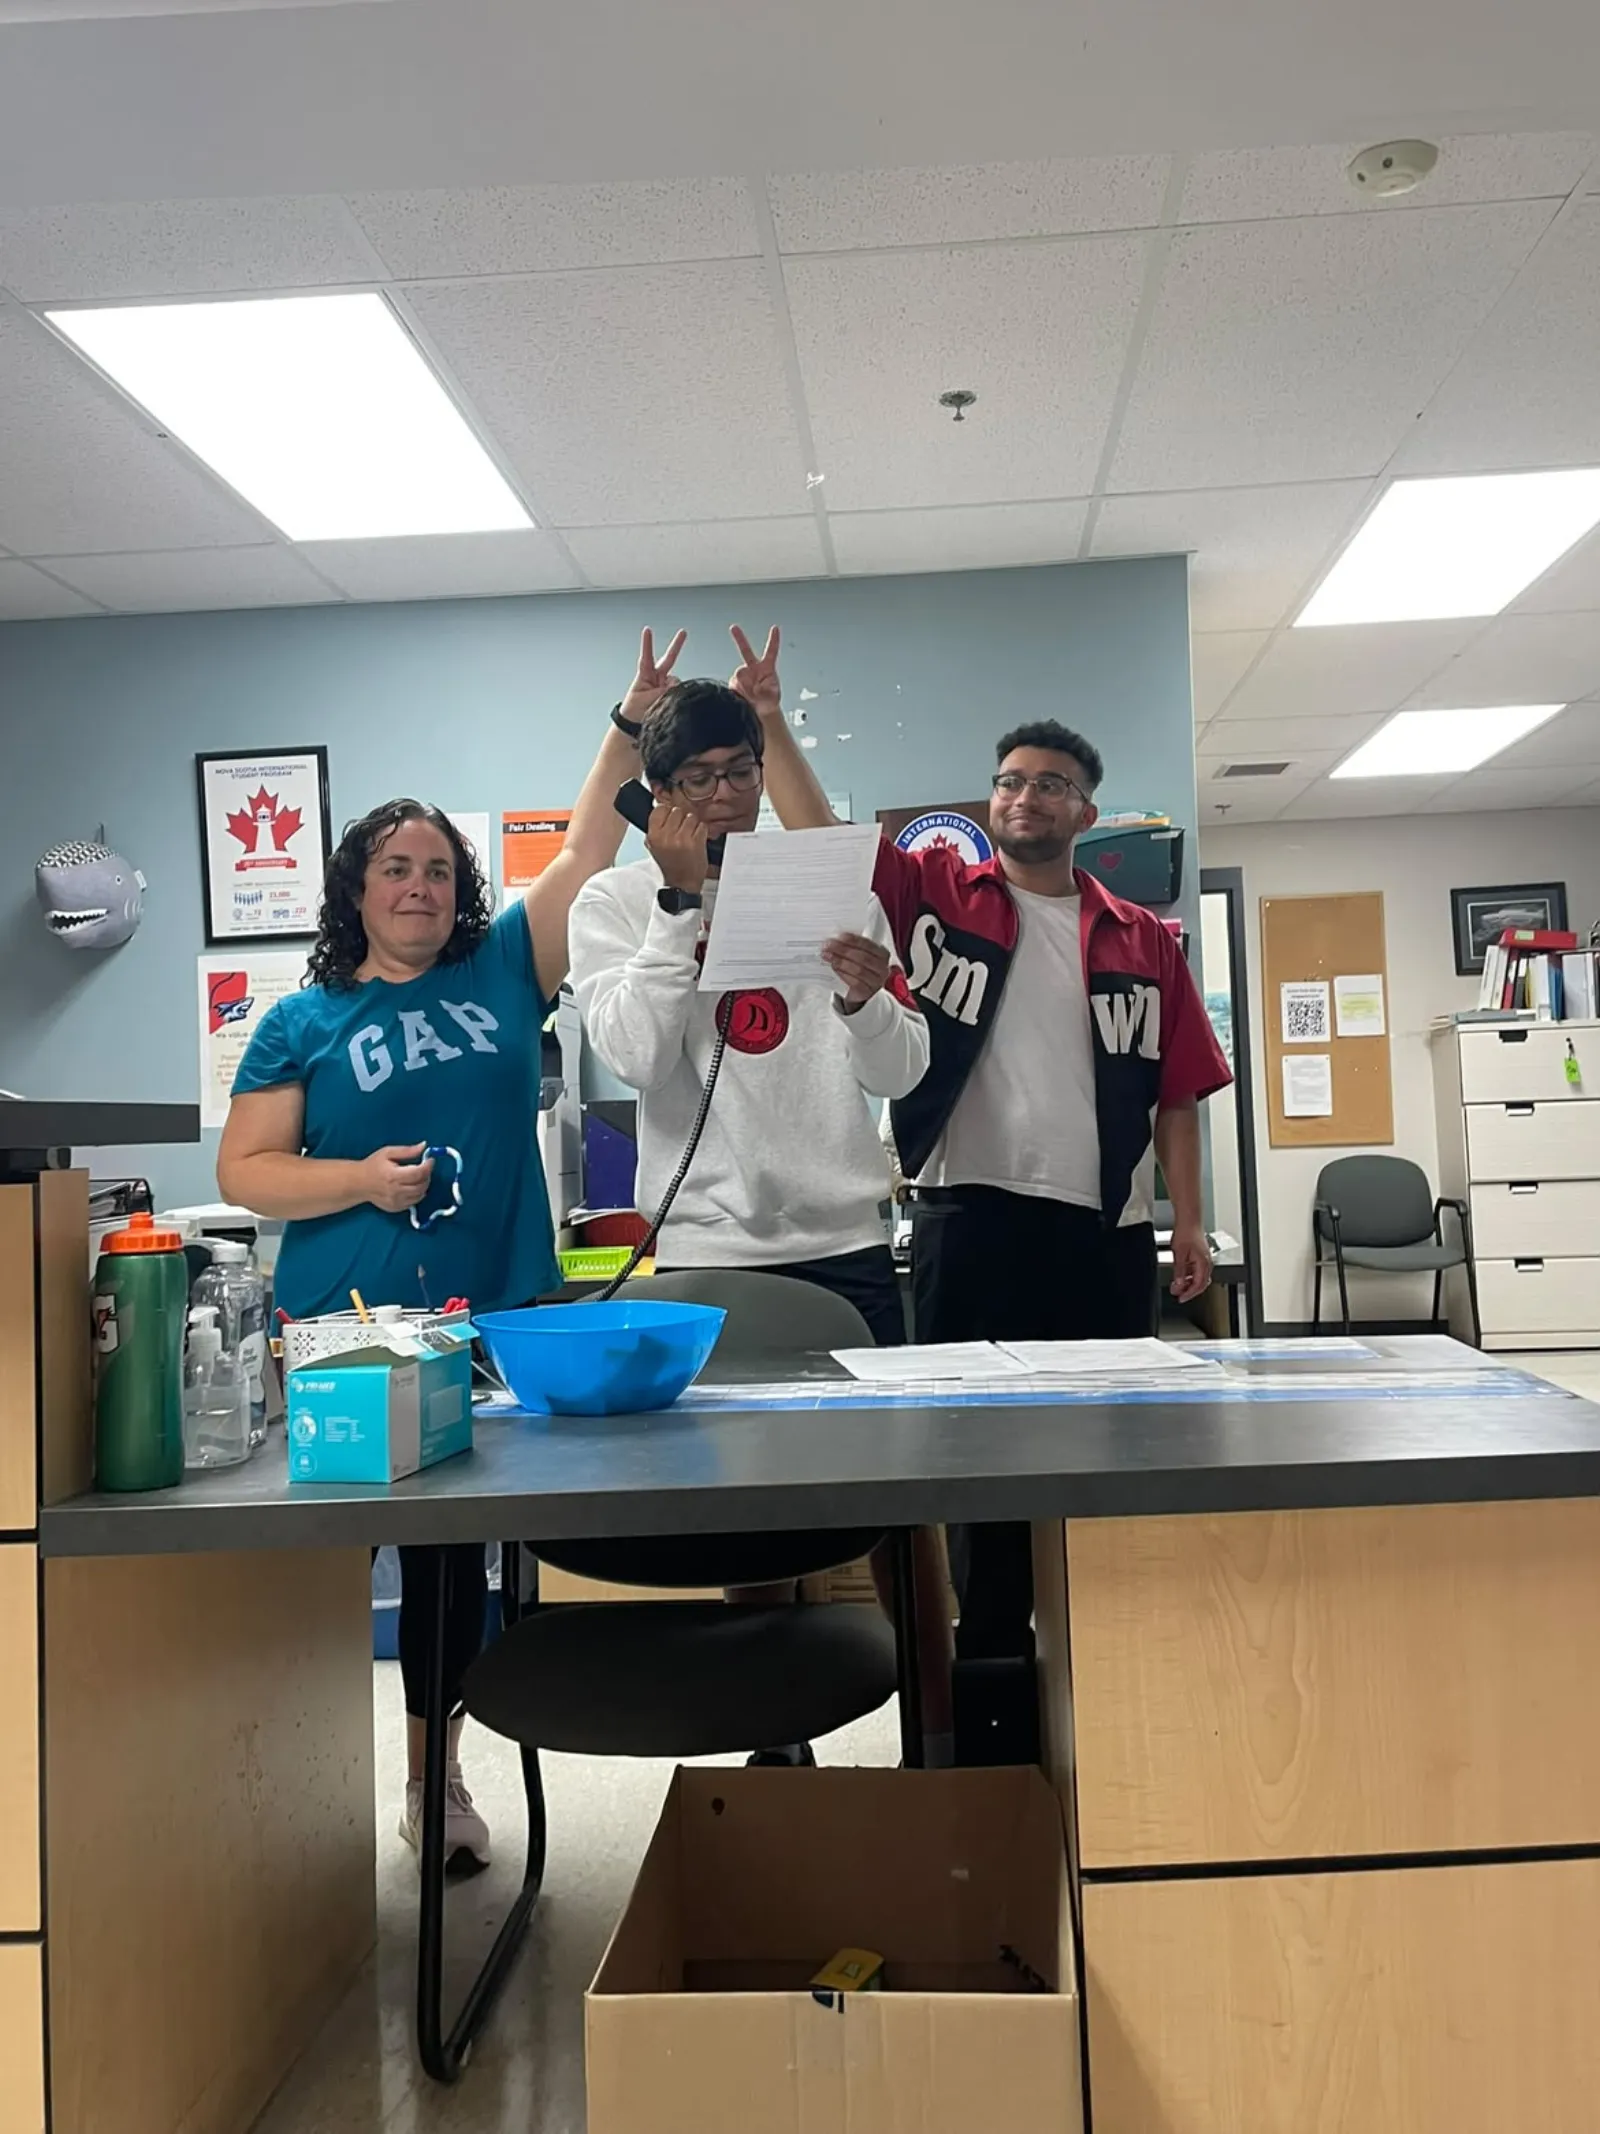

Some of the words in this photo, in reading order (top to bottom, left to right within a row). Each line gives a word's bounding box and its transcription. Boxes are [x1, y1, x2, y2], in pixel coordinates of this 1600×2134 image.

[509, 823, 524, 832] Fair
[525, 822, 556, 832] Dealing
[901, 816, 976, 844] INTERNATIONAL
[348, 1000, 499, 1092] GAP
